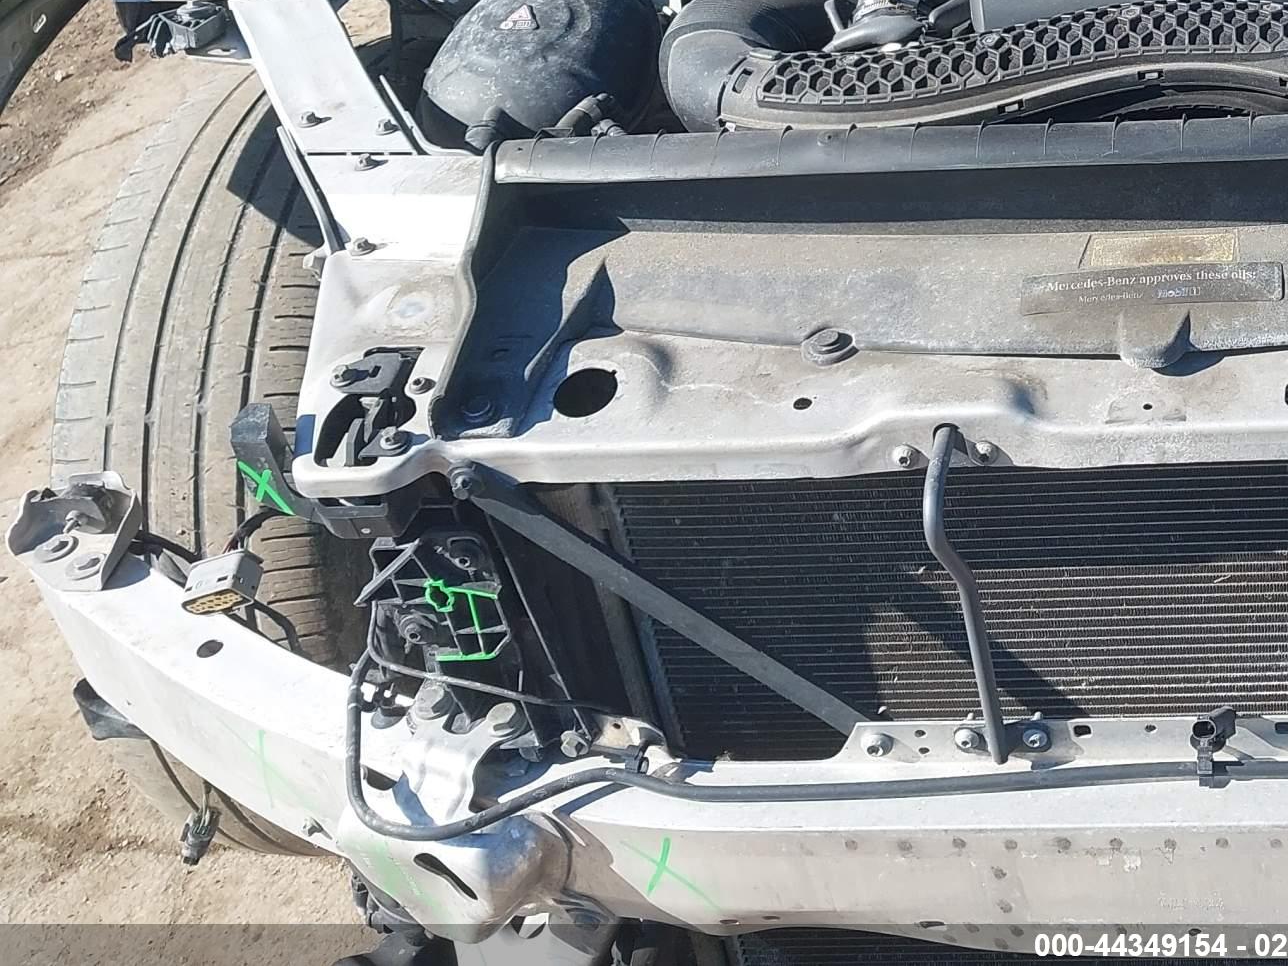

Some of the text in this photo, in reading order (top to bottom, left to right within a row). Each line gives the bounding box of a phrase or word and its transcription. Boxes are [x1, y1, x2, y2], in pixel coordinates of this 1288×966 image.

[1046, 275, 1138, 292] Mercedes-Benz
[1139, 272, 1193, 286] approves
[1196, 270, 1229, 281] these
[1078, 291, 1144, 304] Mercedes-Benz
